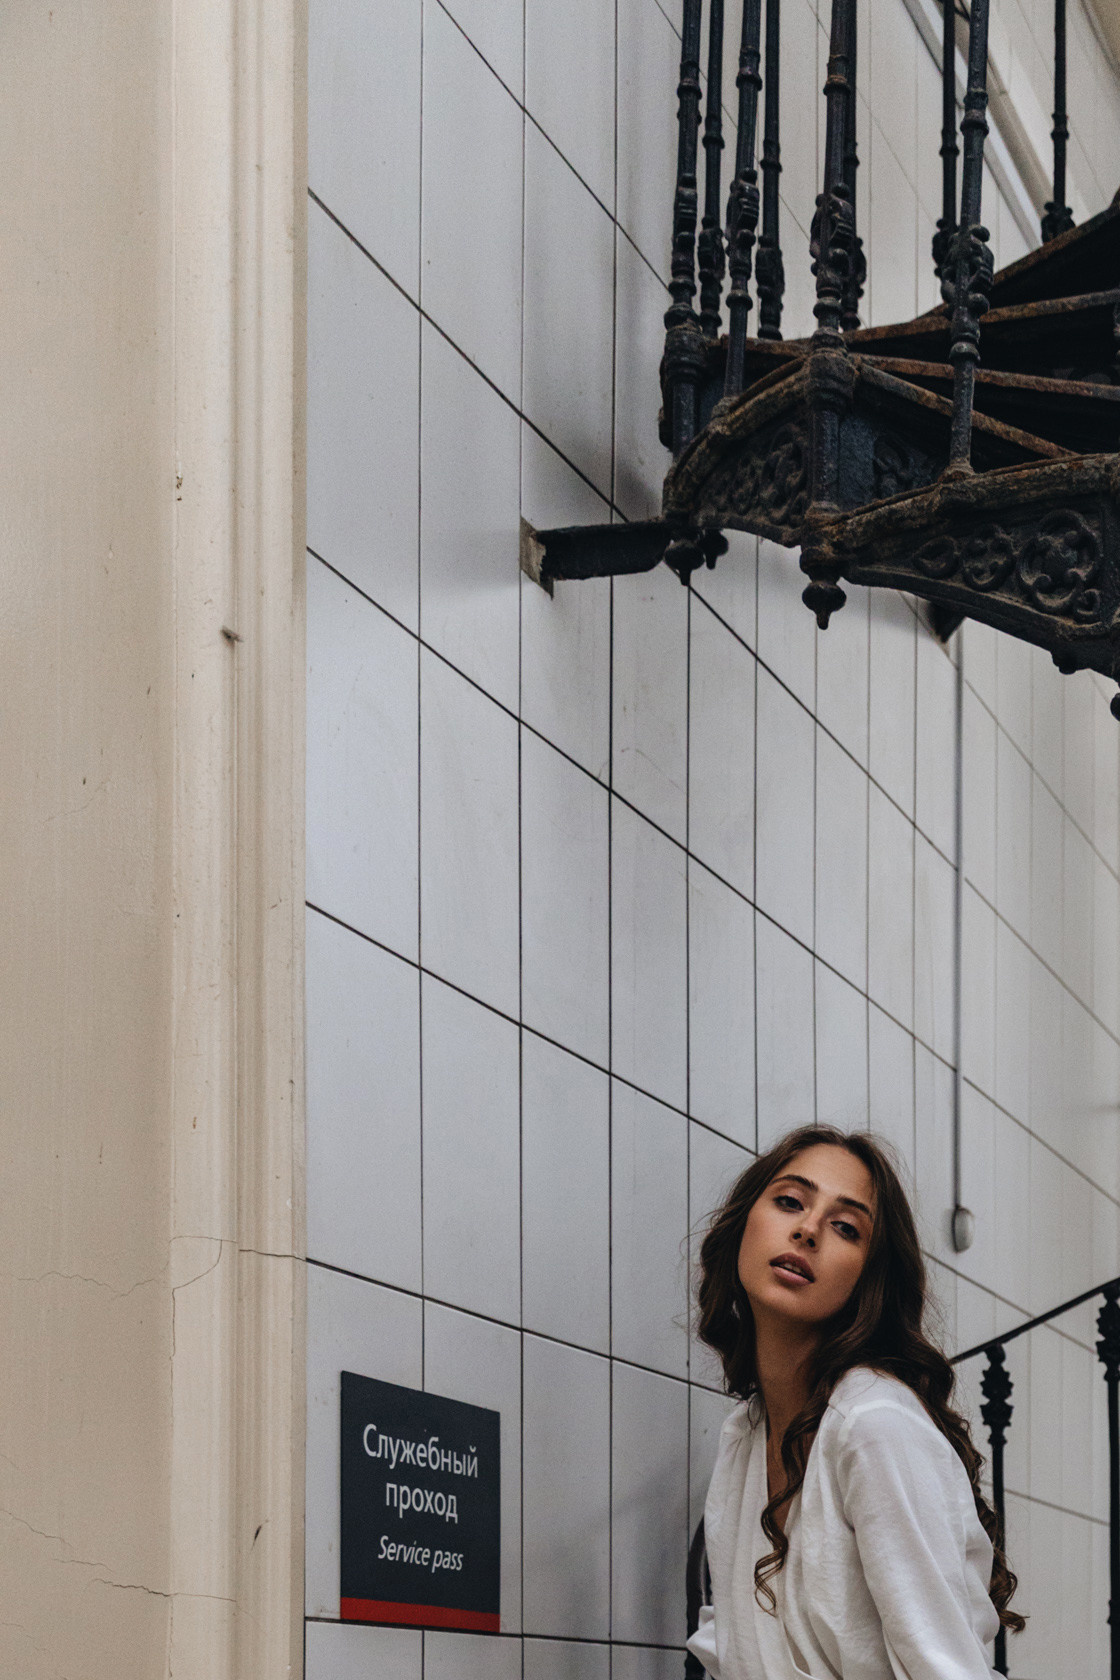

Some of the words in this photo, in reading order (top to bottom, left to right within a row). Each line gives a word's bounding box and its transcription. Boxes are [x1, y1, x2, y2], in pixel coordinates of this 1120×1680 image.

[362, 1423, 479, 1479] Служебный
[385, 1482, 459, 1524] проход
[377, 1535, 431, 1566] Service
[431, 1549, 464, 1573] pass
